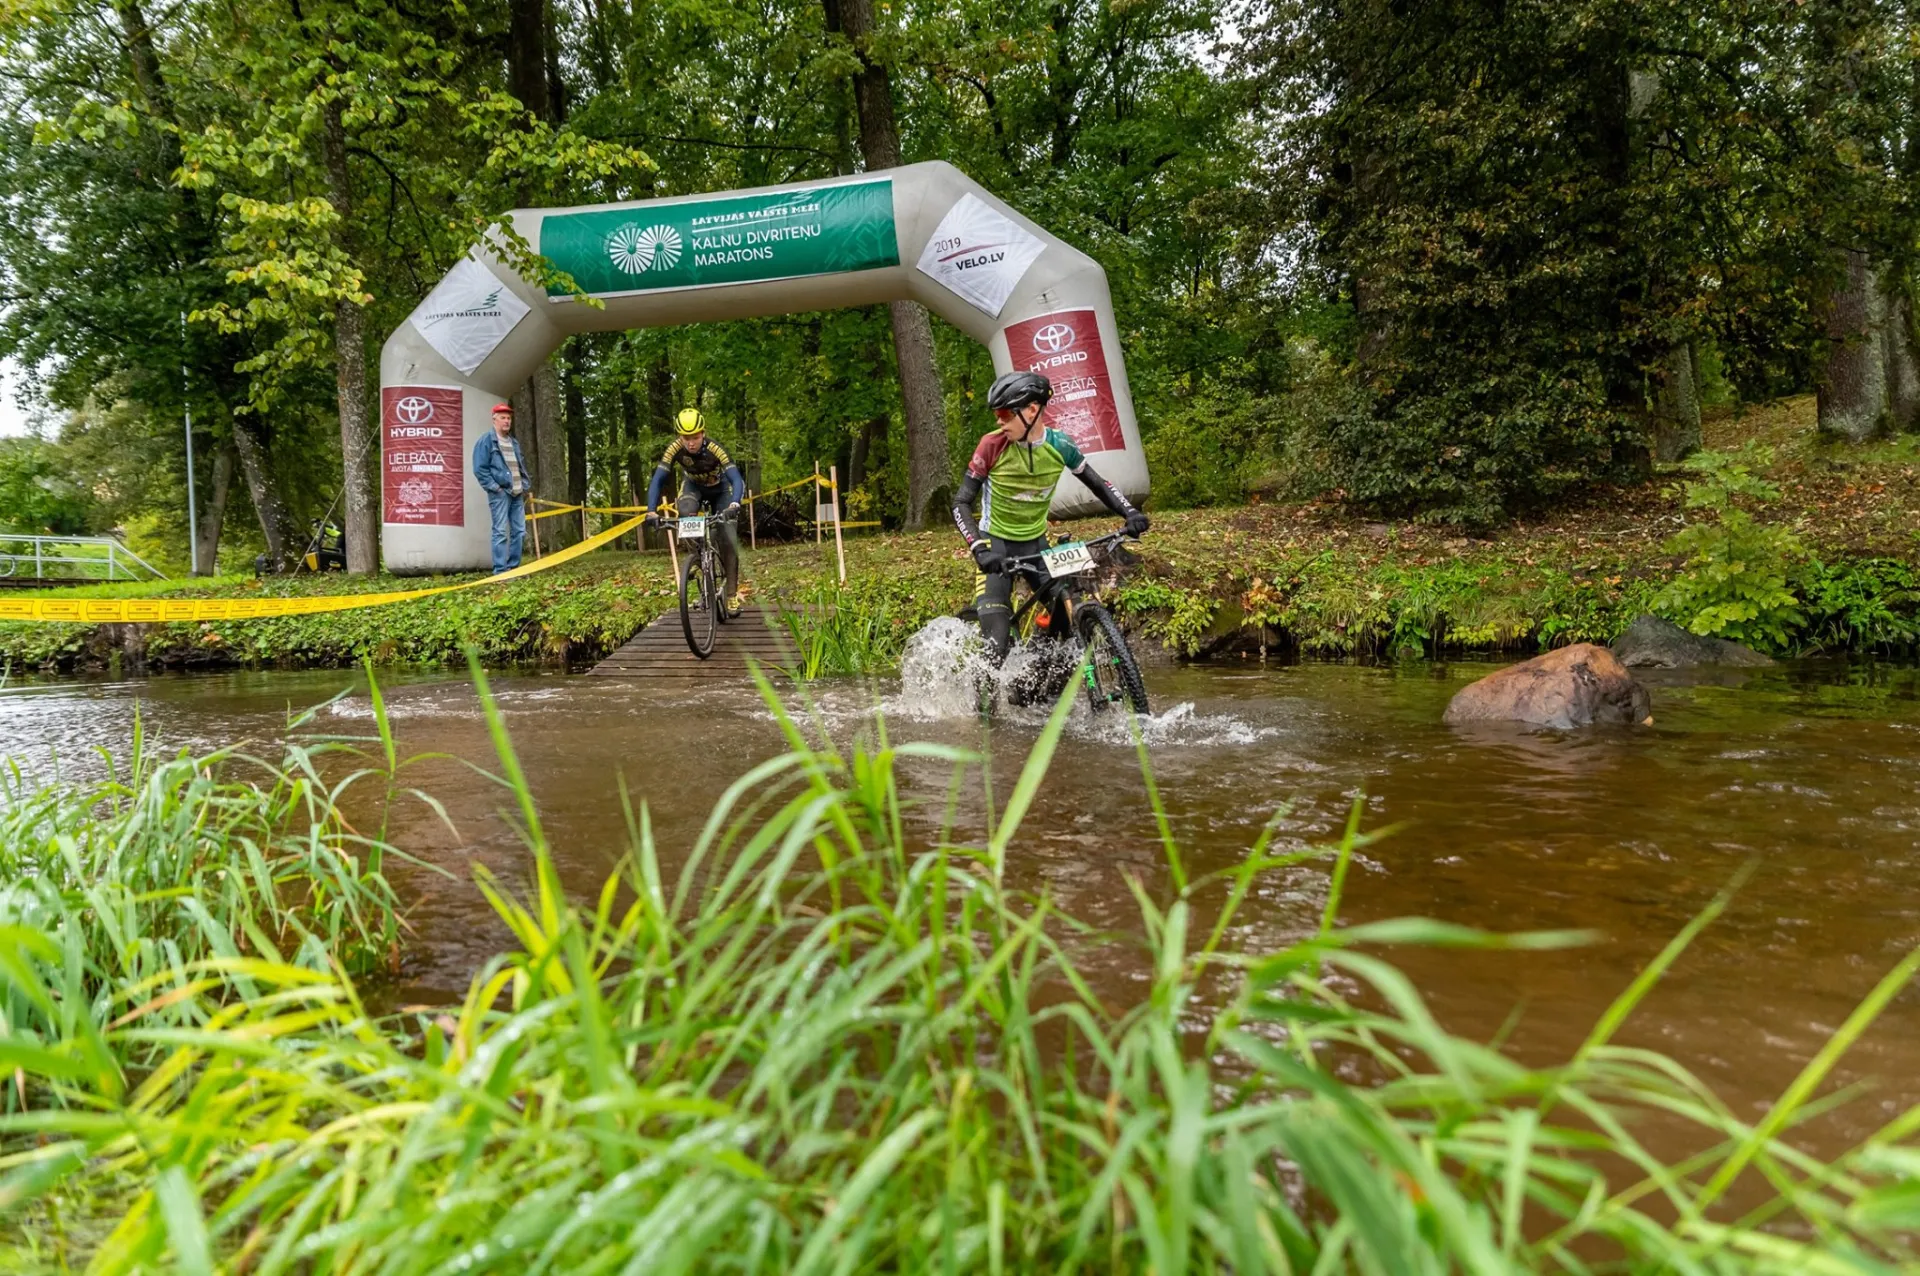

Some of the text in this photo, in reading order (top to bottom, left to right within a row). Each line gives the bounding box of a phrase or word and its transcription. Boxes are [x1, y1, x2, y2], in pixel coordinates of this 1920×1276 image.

[691, 203, 820, 226] LATVIJAS VALSTS MEŽI
[692, 223, 821, 250] KALNU DIVRITEŅU
[935, 236, 962, 254] 2019
[694, 246, 774, 267] MARATONS
[955, 251, 1005, 271] VELO.LV
[1029, 351, 1088, 373] HYBRID
[1052, 376, 1098, 397] LBĀTA
[390, 427, 443, 438] HYBRID
[682, 521, 701, 530] 5004
[1051, 548, 1082, 565] 5001
